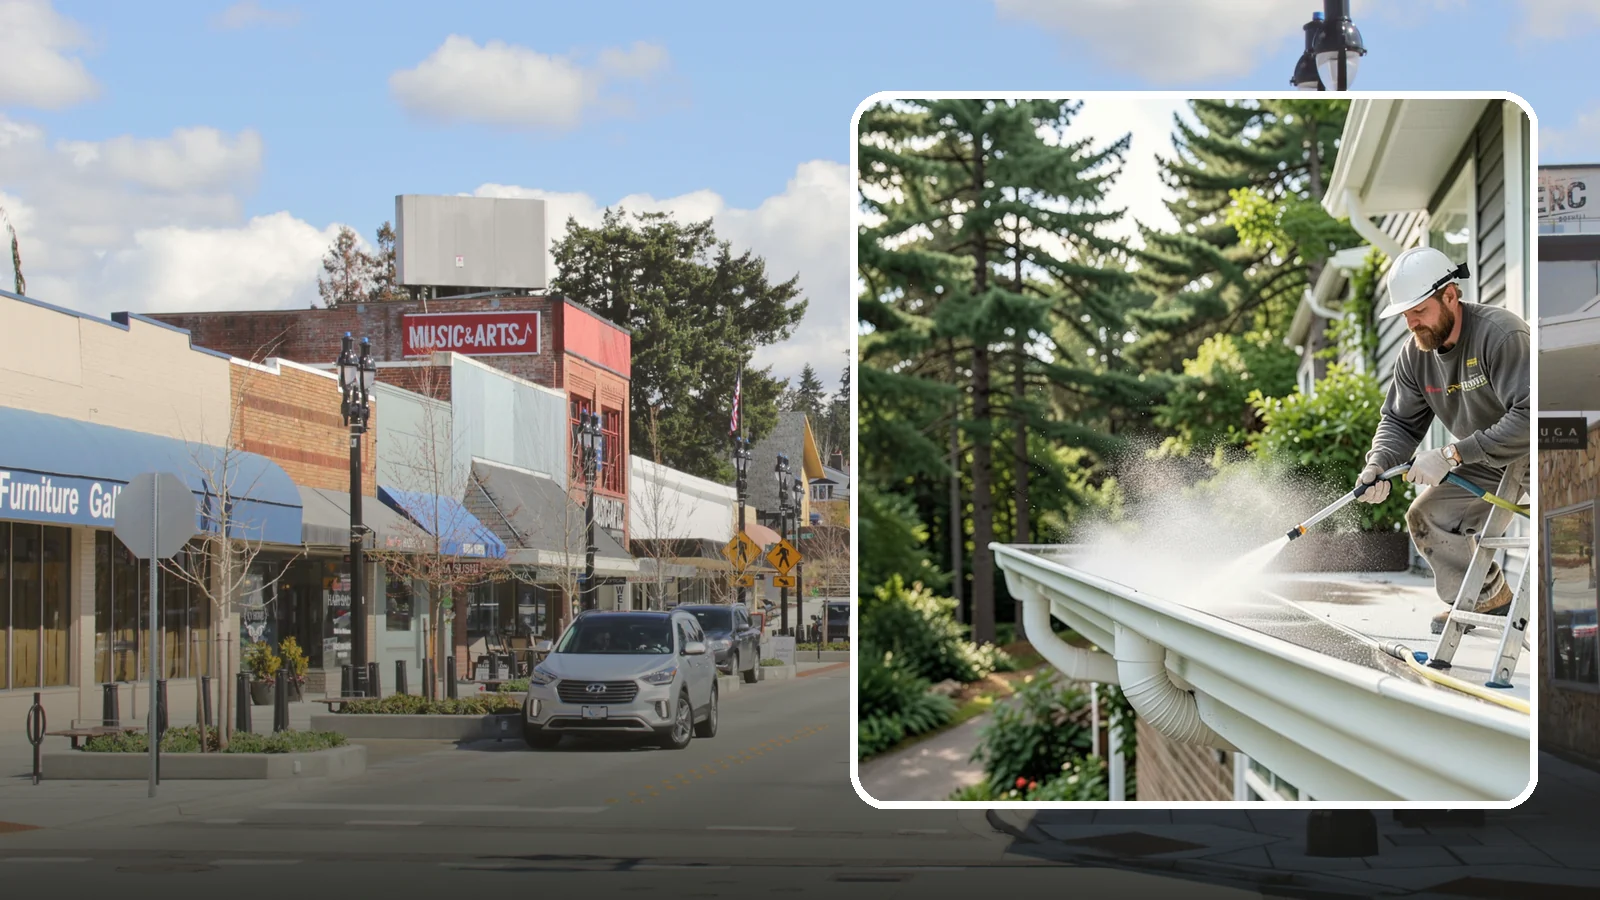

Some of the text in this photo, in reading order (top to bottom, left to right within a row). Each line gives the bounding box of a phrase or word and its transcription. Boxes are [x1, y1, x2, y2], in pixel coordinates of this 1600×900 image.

[1540, 427, 1577, 436] UGA
[0, 471, 79, 515] Furniture
[453, 563, 480, 574] SUSHI
